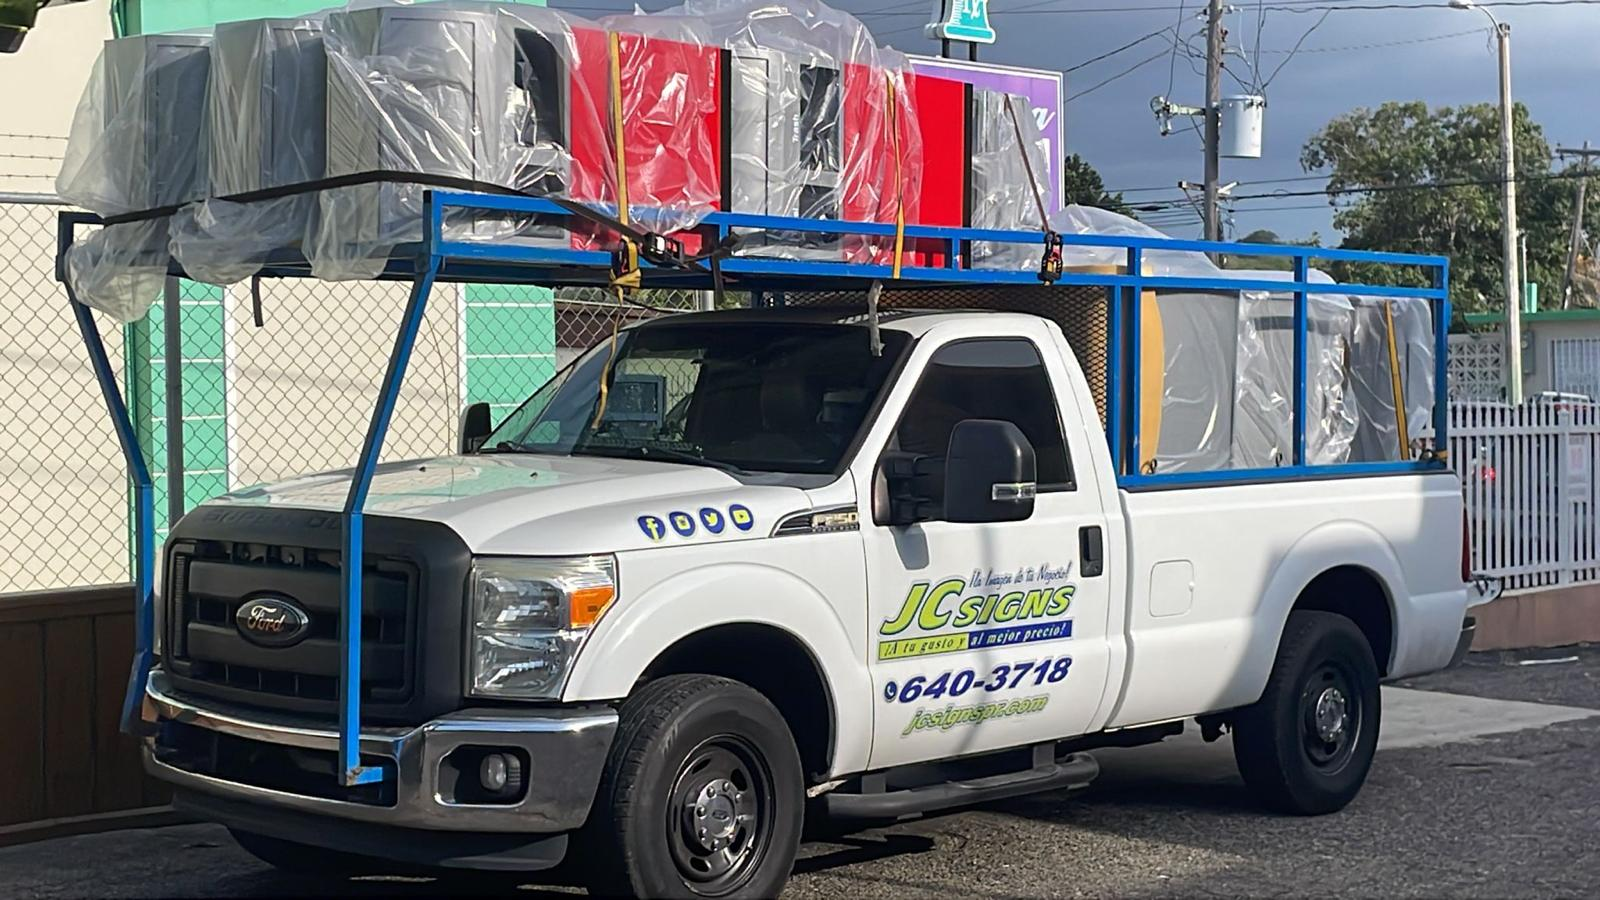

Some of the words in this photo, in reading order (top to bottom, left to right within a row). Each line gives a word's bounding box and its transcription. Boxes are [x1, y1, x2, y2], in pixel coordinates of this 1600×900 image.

[247, 605, 287, 632] Ford
[903, 643, 915, 653] tu
[922, 639, 954, 654] gusto
[957, 638, 966, 650] y
[970, 632, 983, 646] al
[987, 630, 1020, 645] mejor
[1023, 623, 1066, 642] precio!
[898, 657, 1073, 703] 640-3718
[902, 696, 1049, 736] jcsignspr.com
